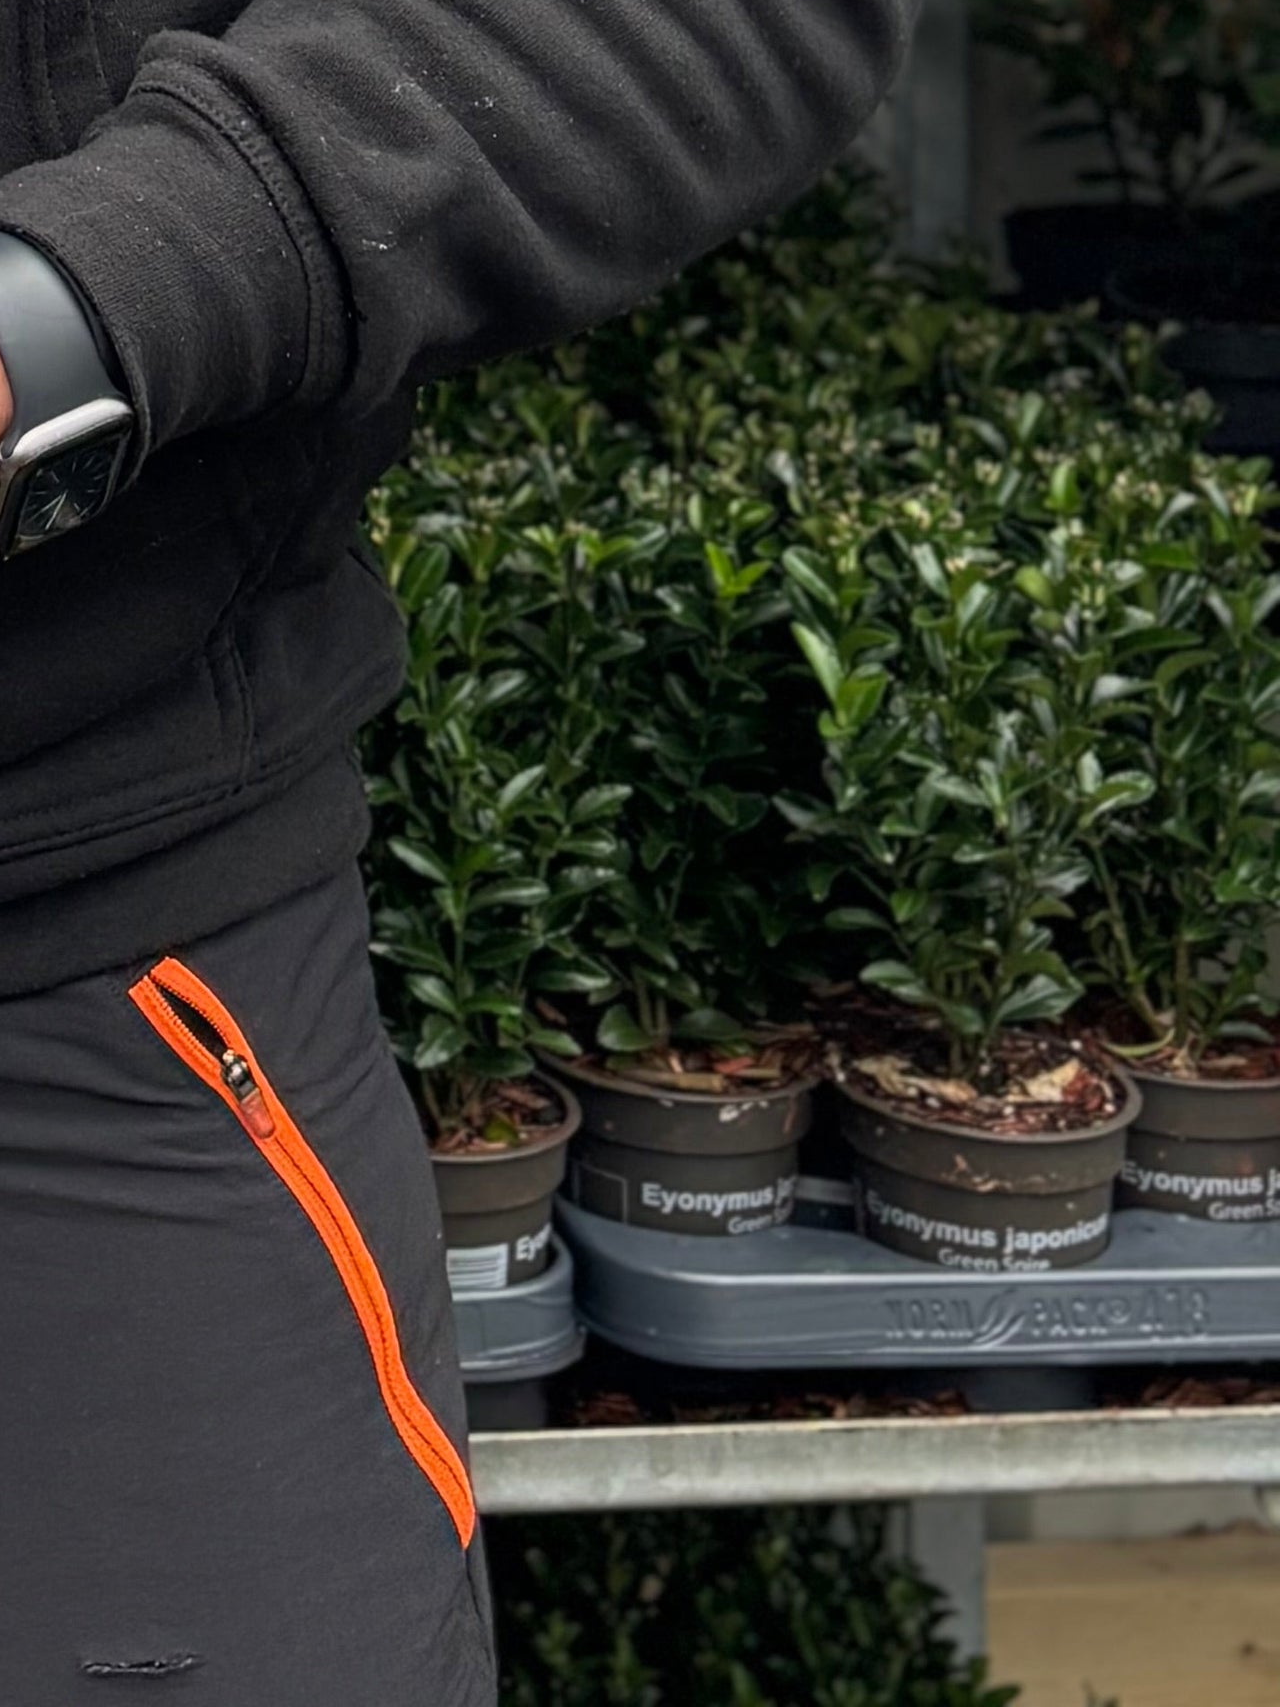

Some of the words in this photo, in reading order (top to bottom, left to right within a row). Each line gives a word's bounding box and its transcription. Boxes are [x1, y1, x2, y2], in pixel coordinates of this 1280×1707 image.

[1122, 1161, 1265, 1201] Eyonymus
[641, 1183, 773, 1216] Eyonymus
[1208, 1201, 1265, 1220] Green
[728, 1213, 773, 1235] Green
[866, 1189, 997, 1248] Eyonymus
[938, 1247, 998, 1272] Green
